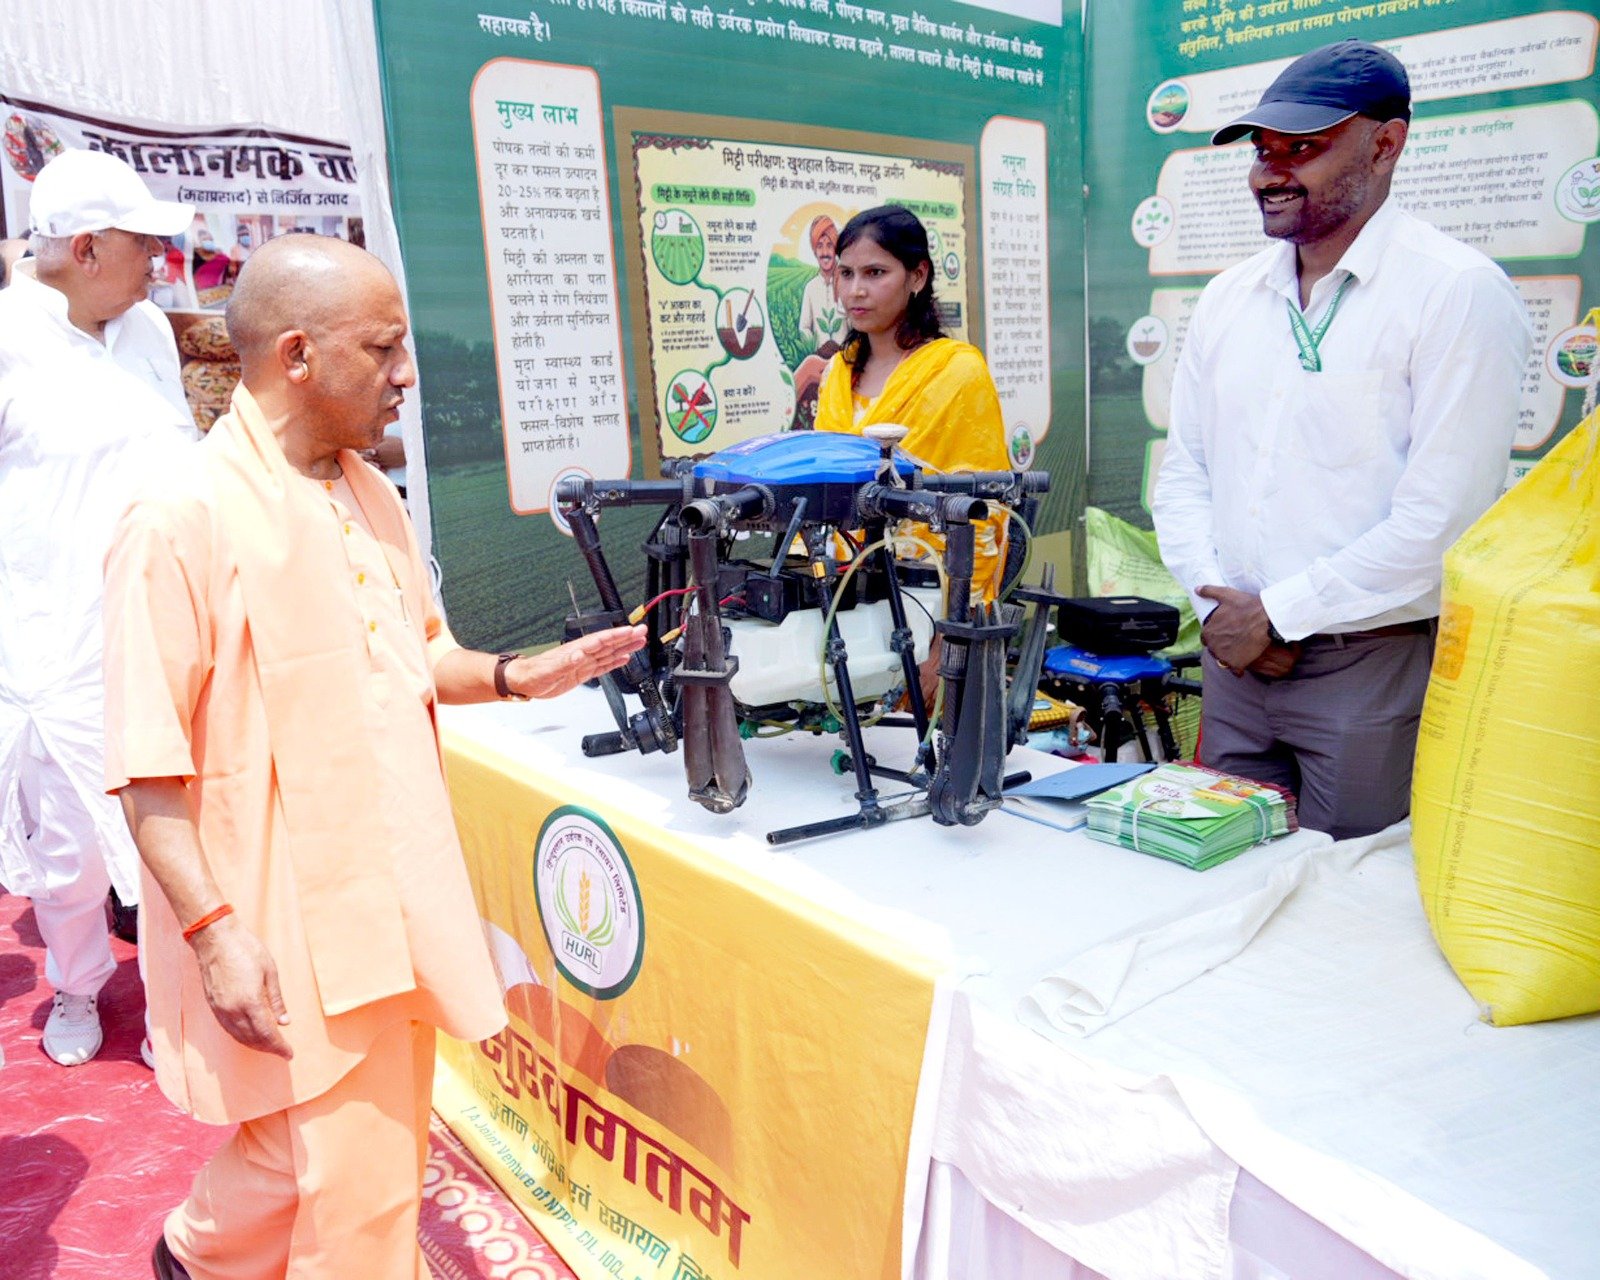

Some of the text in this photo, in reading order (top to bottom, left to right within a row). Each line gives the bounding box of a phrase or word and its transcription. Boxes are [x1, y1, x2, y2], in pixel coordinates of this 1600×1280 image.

[1211, 9, 1236, 32] भूमि
[1240, 4, 1254, 21] की
[1337, 5, 1376, 23] पोषण
[477, 13, 530, 38] सहायक
[866, 8, 889, 31] मान,
[965, 24, 983, 47] और
[670, 4, 686, 24] को
[691, 5, 713, 29] सही
[716, 9, 752, 34] उर्वरक
[755, 17, 785, 39] प्रयोग
[832, 33, 856, 51] उपज
[944, 49, 962, 71] और
[495, 100, 579, 129] मुख्य लाभ
[493, 137, 596, 160] पोषक तत्वों की कमी
[494, 162, 598, 182] दूर कर फसल उत्पादन
[723, 147, 744, 173] मिट्टी
[747, 148, 785, 170] परीक्षण:
[787, 155, 823, 176] खुशहाल
[825, 155, 858, 178] किसान,
[883, 162, 905, 180] जमीन
[257, 187, 269, 206] से
[498, 184, 541, 199] 20-25%
[543, 186, 562, 199] तक
[500, 202, 601, 221] और अनावश्यक खर्च
[503, 248, 605, 268] मिट्टी की अम्लता या
[507, 271, 607, 287] क्षारीयता का पता
[507, 290, 534, 307] चलने
[552, 291, 570, 306] रोग
[574, 290, 608, 306] नियंत्रण
[510, 310, 610, 331] और उर्वरता सुनिश्चित
[514, 351, 613, 375] मृदा स्वास्थ्य कार्ड
[516, 376, 557, 392] योजना
[589, 374, 616, 391] मुफ्त
[518, 390, 617, 412] परीक्षण और
[592, 412, 620, 427] सलाह
[565, 937, 599, 969] HURL
[497, 1143, 537, 1189] Venture
[531, 1186, 552, 1202] of
[598, 1199, 671, 1269] रसायन
